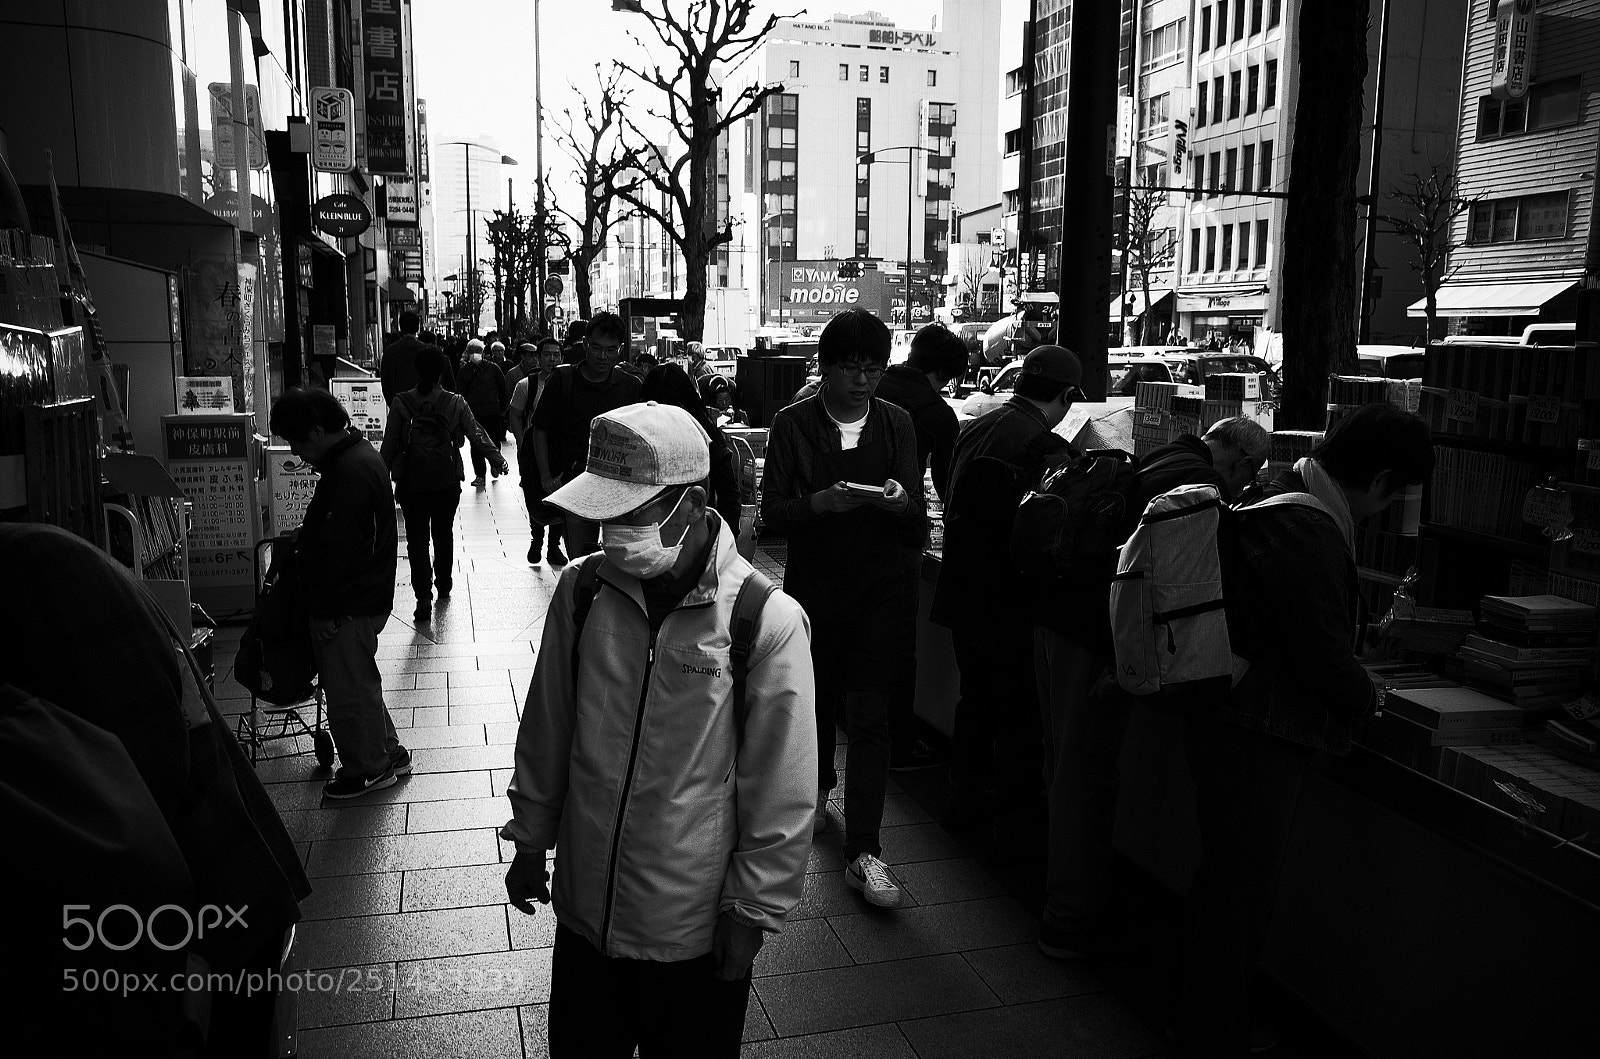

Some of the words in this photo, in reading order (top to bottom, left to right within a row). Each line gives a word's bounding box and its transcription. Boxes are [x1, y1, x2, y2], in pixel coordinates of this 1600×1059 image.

[1512, 18, 1528, 81] 山田書店
[790, 284, 860, 304] mobile
[173, 426, 240, 441] 神保町駅前
[188, 442, 228, 456] 皮膚科
[214, 552, 234, 564] 6F
[681, 664, 722, 679] SPALDING
